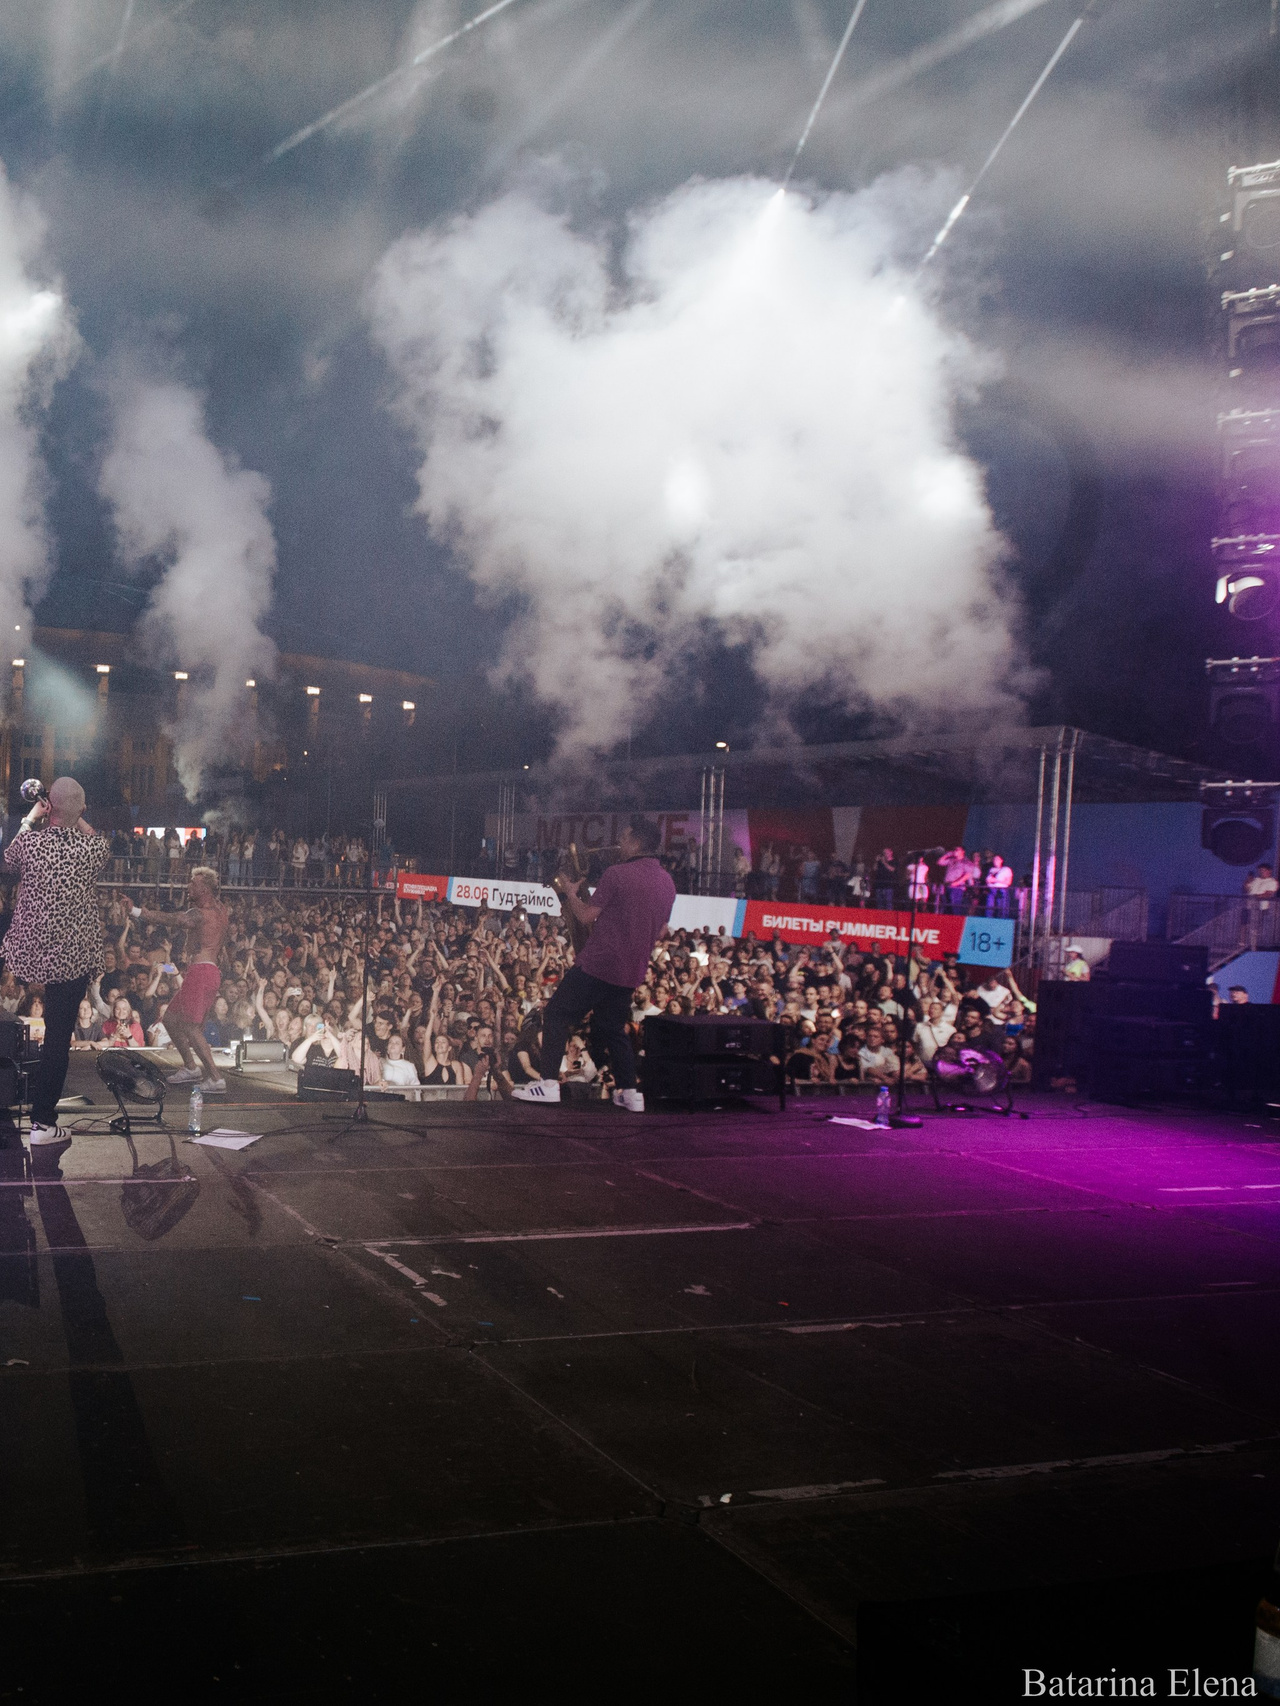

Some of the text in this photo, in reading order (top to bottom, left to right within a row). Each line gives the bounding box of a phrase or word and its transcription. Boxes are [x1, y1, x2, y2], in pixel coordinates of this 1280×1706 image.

[456, 884, 554, 908] 28.06 Гудтаймс
[762, 914, 940, 945] БИЛЕТЫ SUMMER.LIVE
[970, 931, 1007, 953] 18+
